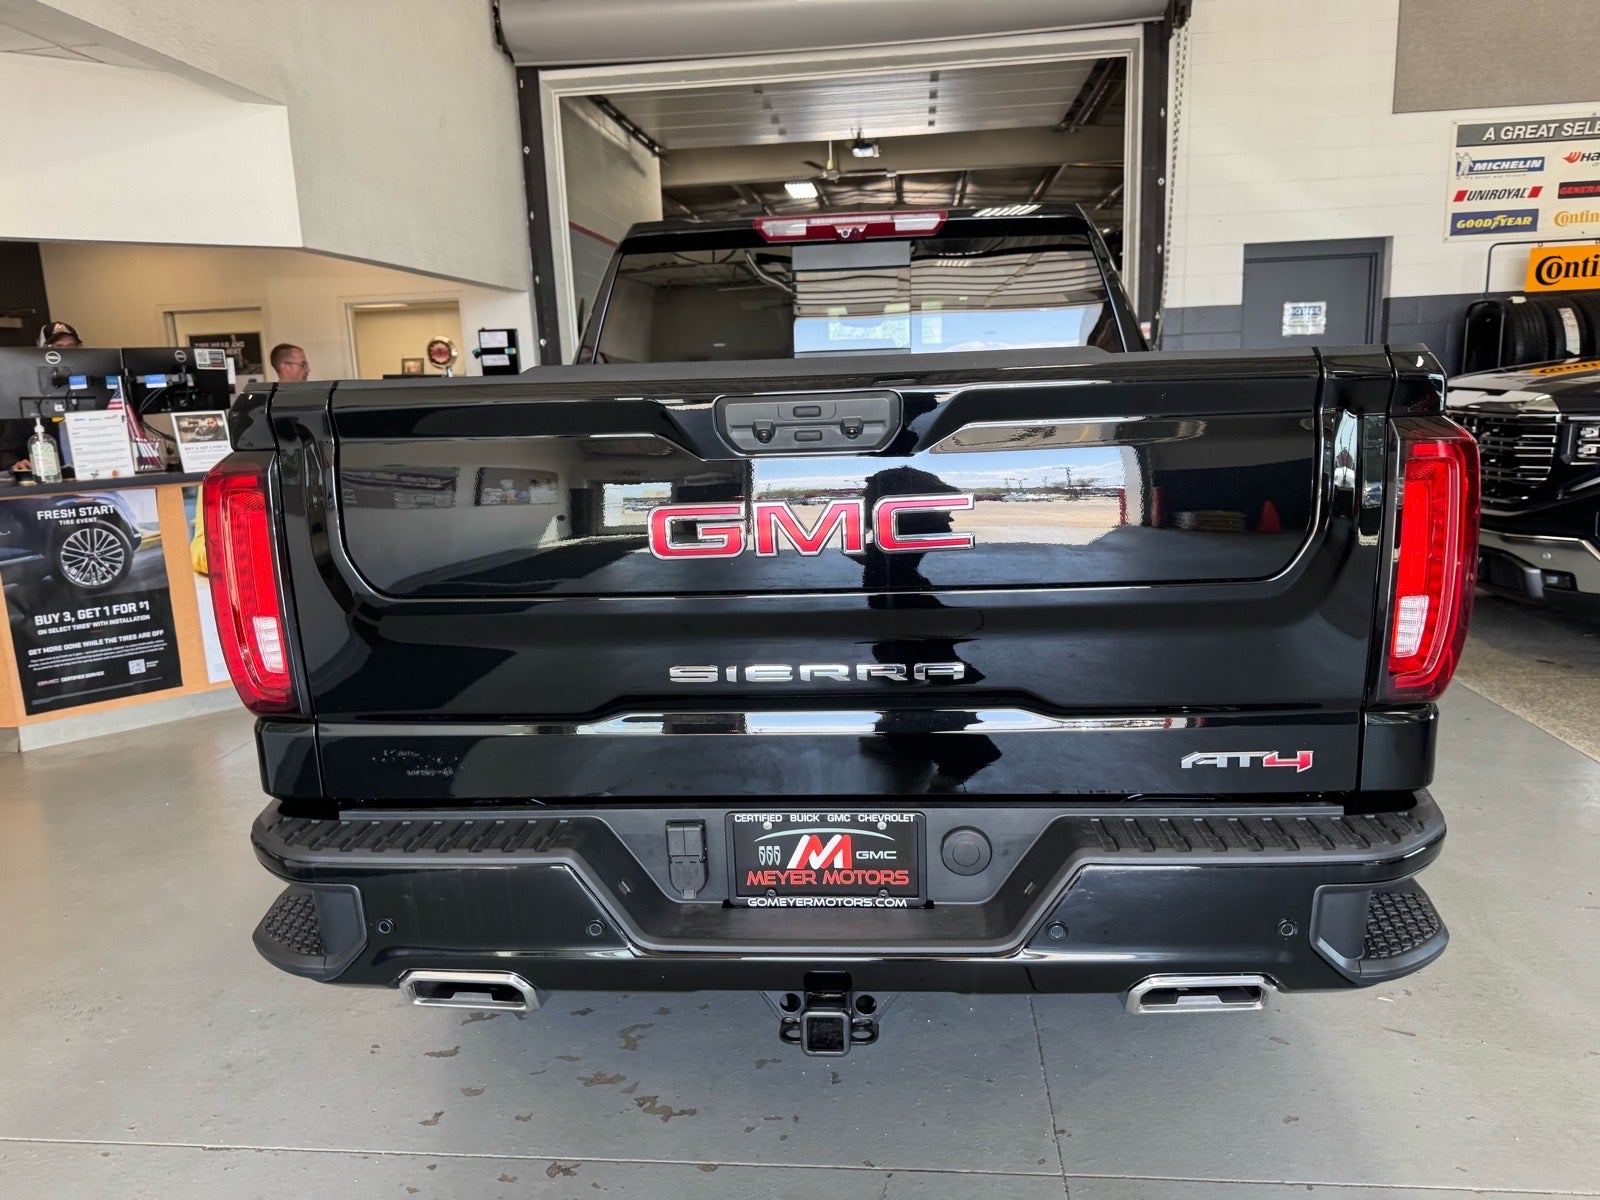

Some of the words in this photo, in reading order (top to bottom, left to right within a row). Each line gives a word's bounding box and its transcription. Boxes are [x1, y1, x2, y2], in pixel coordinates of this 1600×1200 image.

[1482, 127, 1496, 141] A
[1500, 123, 1560, 140] GREAT
[1473, 160, 1544, 171] MICHELIN
[1466, 187, 1528, 201] UNIROYAL
[1456, 215, 1533, 230] GOODYEAR
[1535, 254, 1600, 286] Conti
[36, 508, 77, 521] FRESH
[78, 504, 114, 517] START
[647, 492, 976, 560] GMC
[34, 613, 60, 626] BUY
[62, 611, 75, 622] 3,
[77, 607, 101, 620] GET
[103, 606, 110, 616] 1
[112, 602, 137, 615] FOR
[138, 601, 150, 611] $1
[48, 625, 71, 634] SELECT
[92, 619, 109, 627] WITH
[109, 614, 151, 625] INSTALLATION
[28, 648, 42, 656] GET
[43, 645, 63, 653] MORE
[63, 642, 82, 650] DONE
[82, 639, 104, 647] WHILE
[118, 633, 137, 642] TIRES
[138, 631, 151, 639] ARE
[151, 629, 165, 637] OFF
[669, 662, 966, 683] SIERRA
[1180, 750, 1314, 773] AT4
[734, 814, 783, 823] CERTIFIED
[790, 814, 820, 823] BUICK
[827, 814, 851, 823] GMC
[858, 814, 915, 823] CHEVROLET
[855, 850, 897, 860] GMC
[746, 870, 817, 885] MEYER
[822, 870, 910, 885] MOTORS
[747, 898, 908, 908] GOMEYERMOTORS.COM
